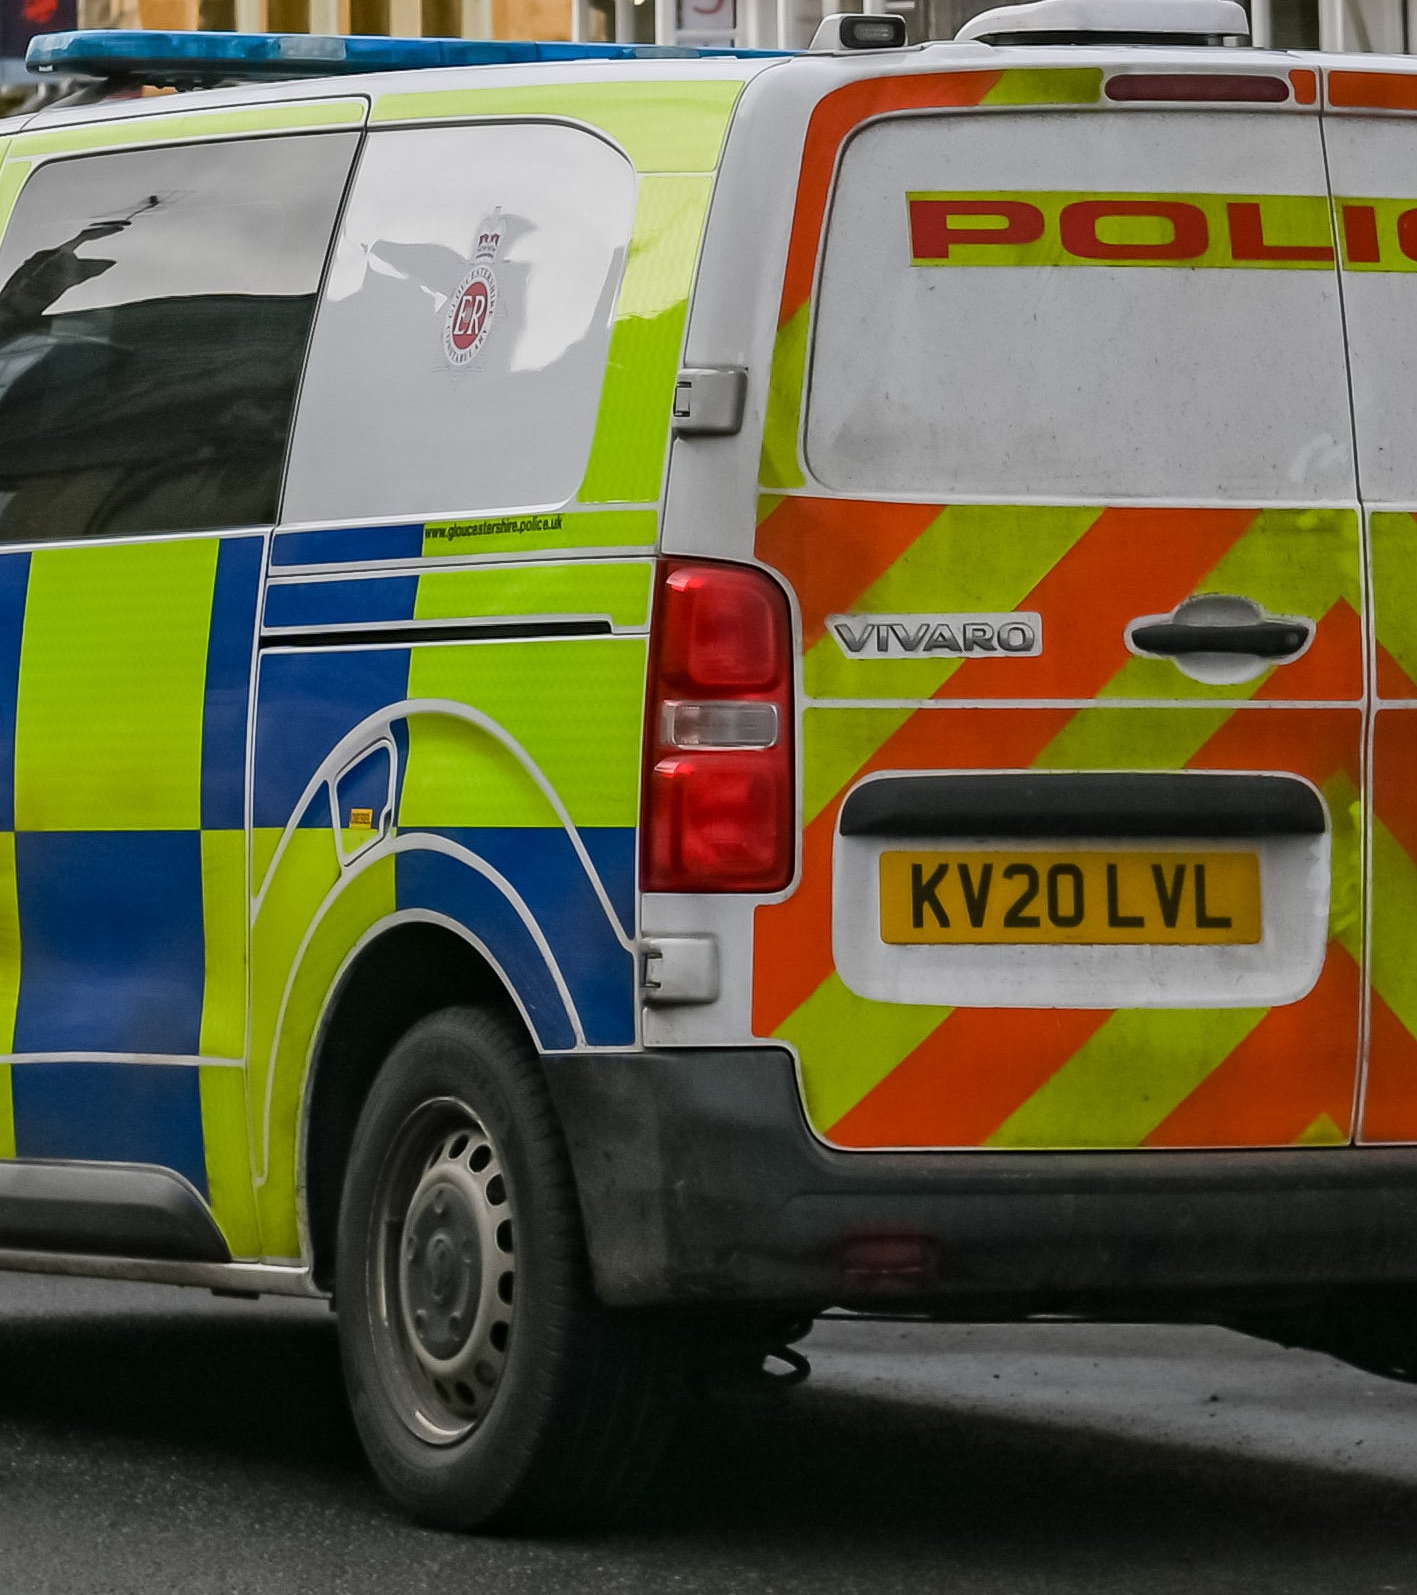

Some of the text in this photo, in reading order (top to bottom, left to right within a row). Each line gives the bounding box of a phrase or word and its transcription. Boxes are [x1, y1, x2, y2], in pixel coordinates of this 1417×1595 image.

[424, 516, 562, 541] www.gloucestershire.police.uk
[833, 621, 1035, 654] VIVARO
[911, 863, 1233, 929] KV20 LVL
